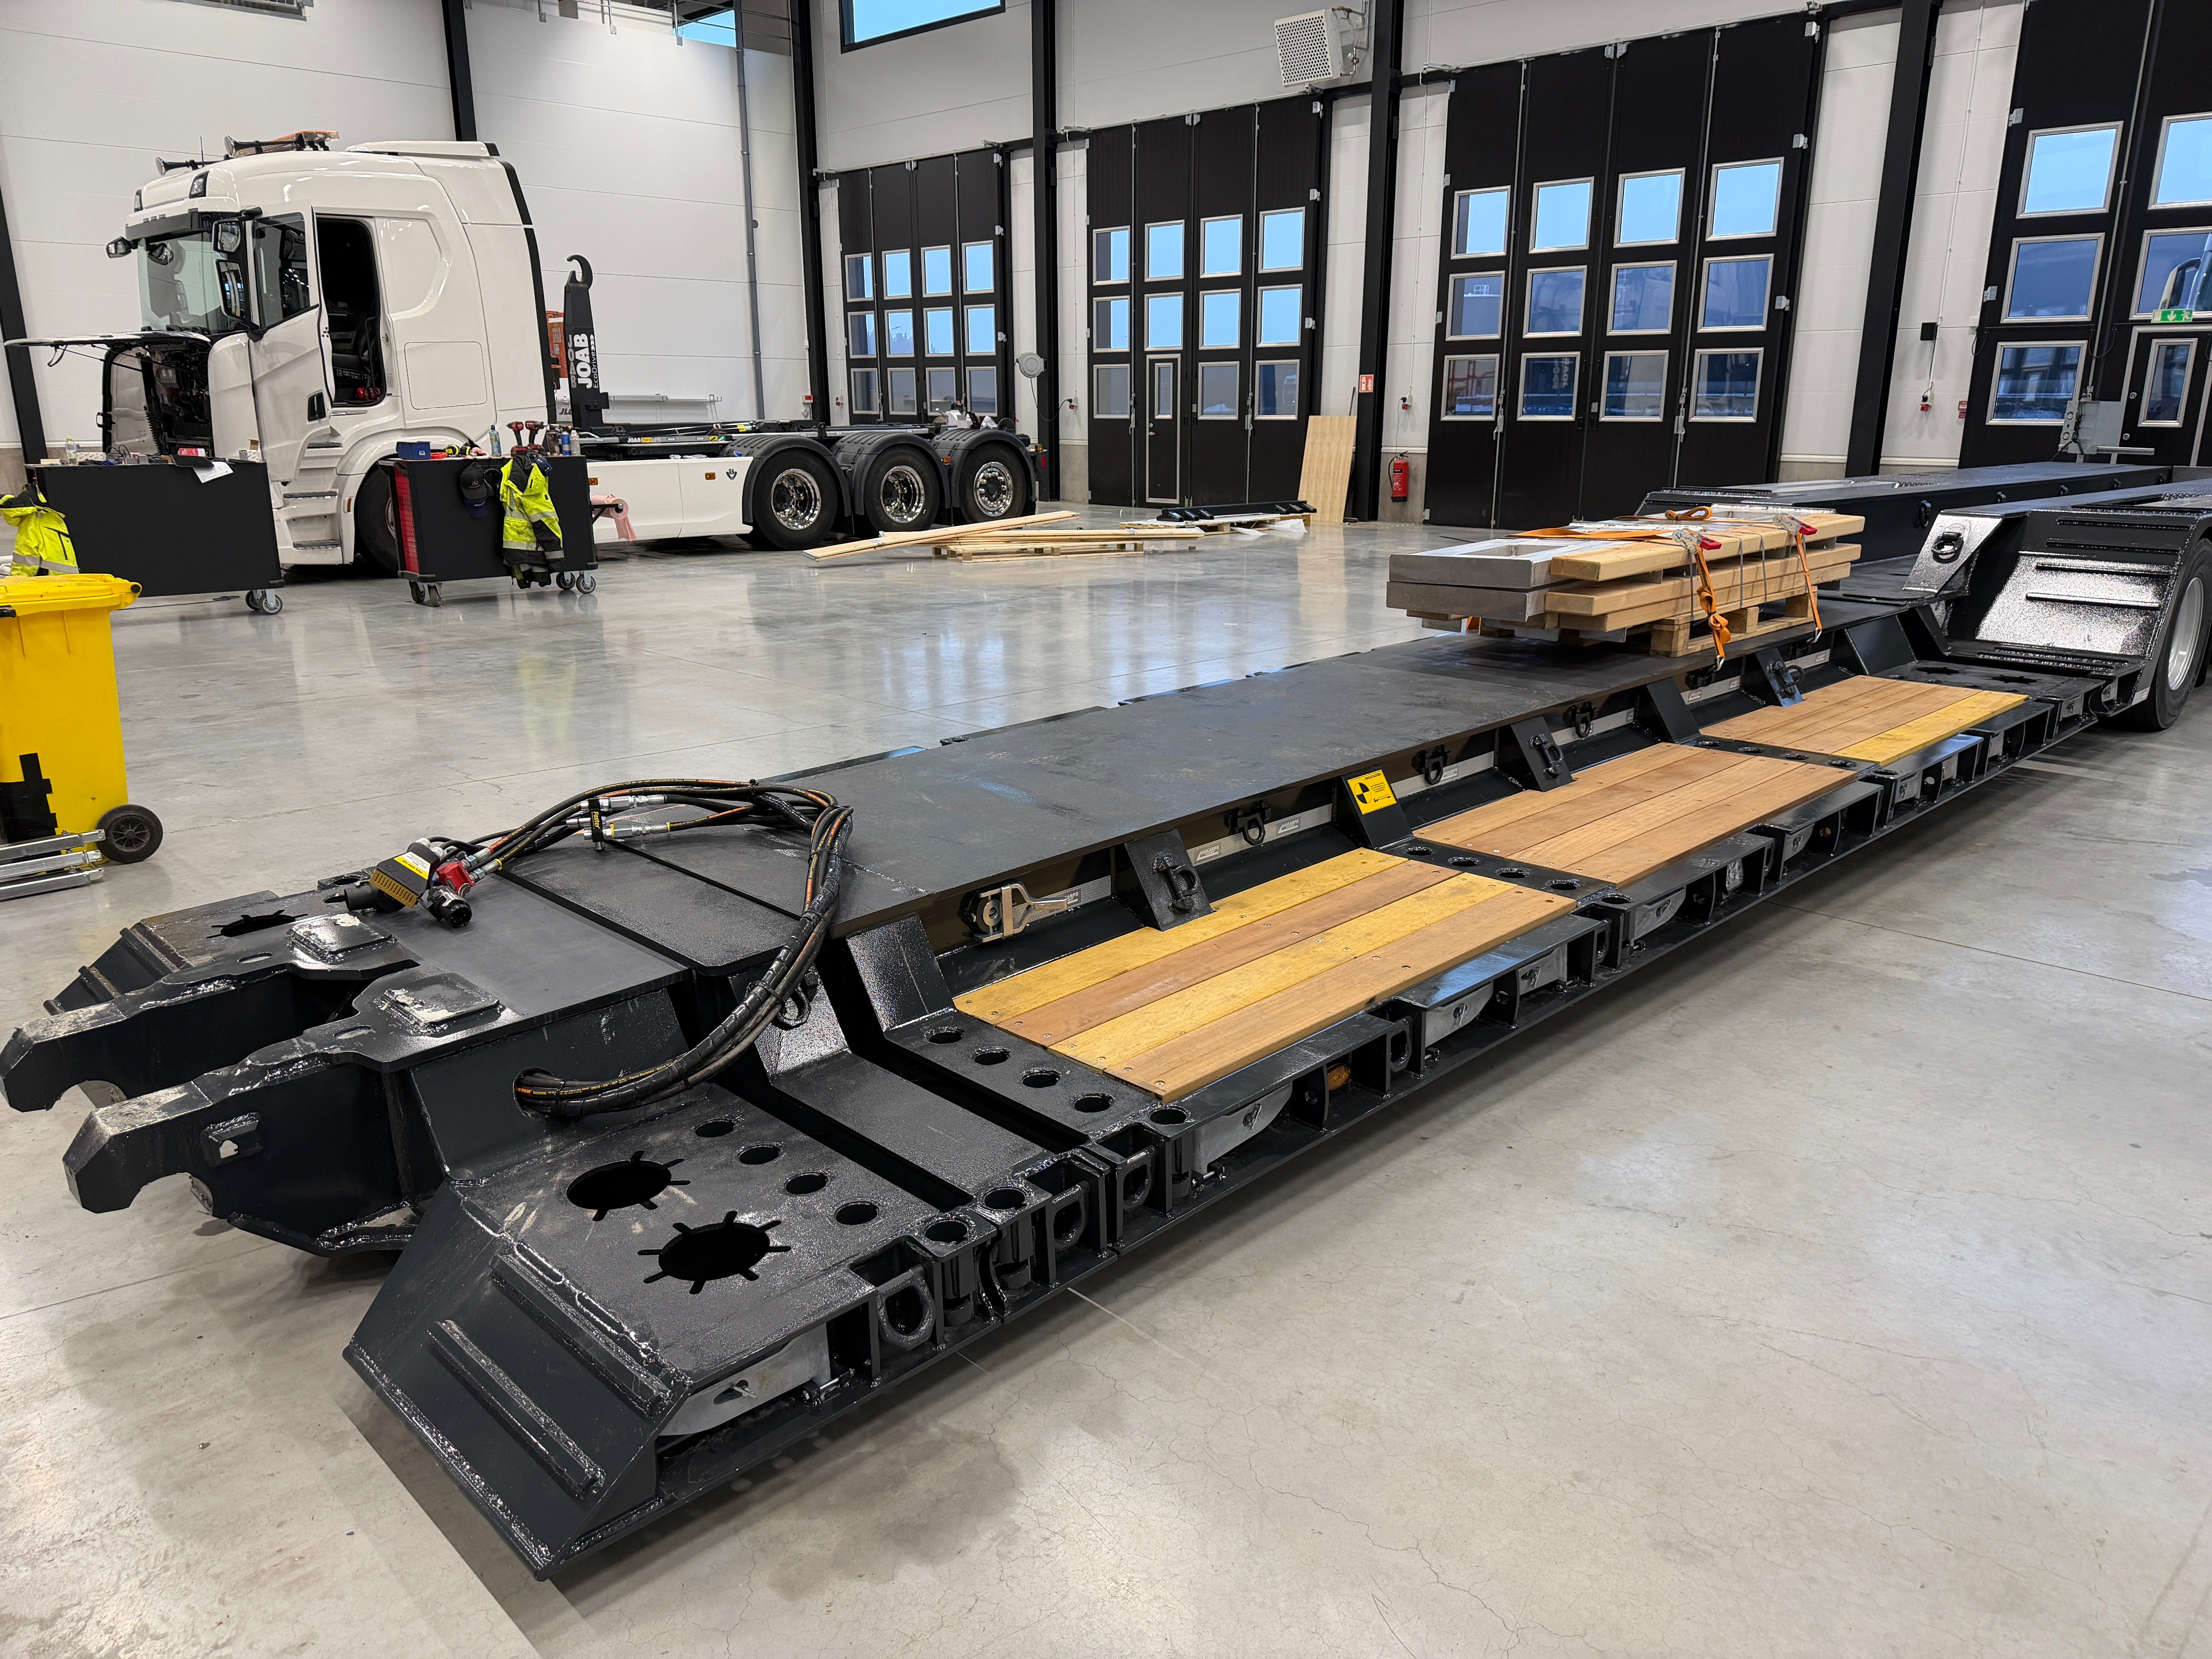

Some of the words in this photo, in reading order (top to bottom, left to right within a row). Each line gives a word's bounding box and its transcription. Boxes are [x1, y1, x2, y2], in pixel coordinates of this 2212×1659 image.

[568, 334, 577, 388] JOAB
[574, 333, 592, 389] JOAB
[1200, 845, 1219, 855] HAKARPS
